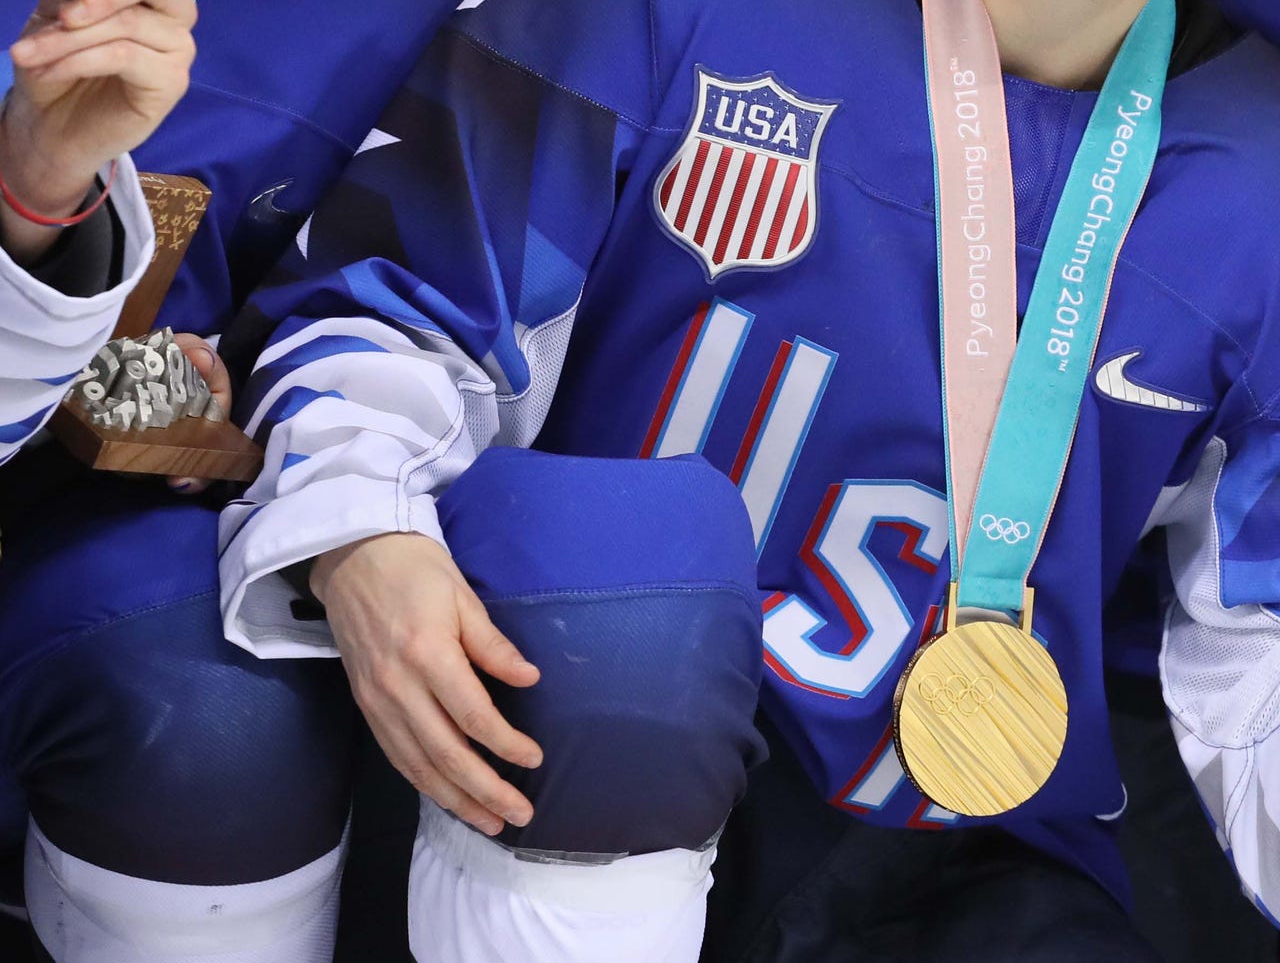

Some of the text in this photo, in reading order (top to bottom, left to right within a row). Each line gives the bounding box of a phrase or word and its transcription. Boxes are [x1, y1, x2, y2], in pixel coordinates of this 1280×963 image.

[714, 95, 798, 150] USA
[1061, 89, 1152, 283] PyeongChang
[961, 143, 993, 358] PyeongChang
